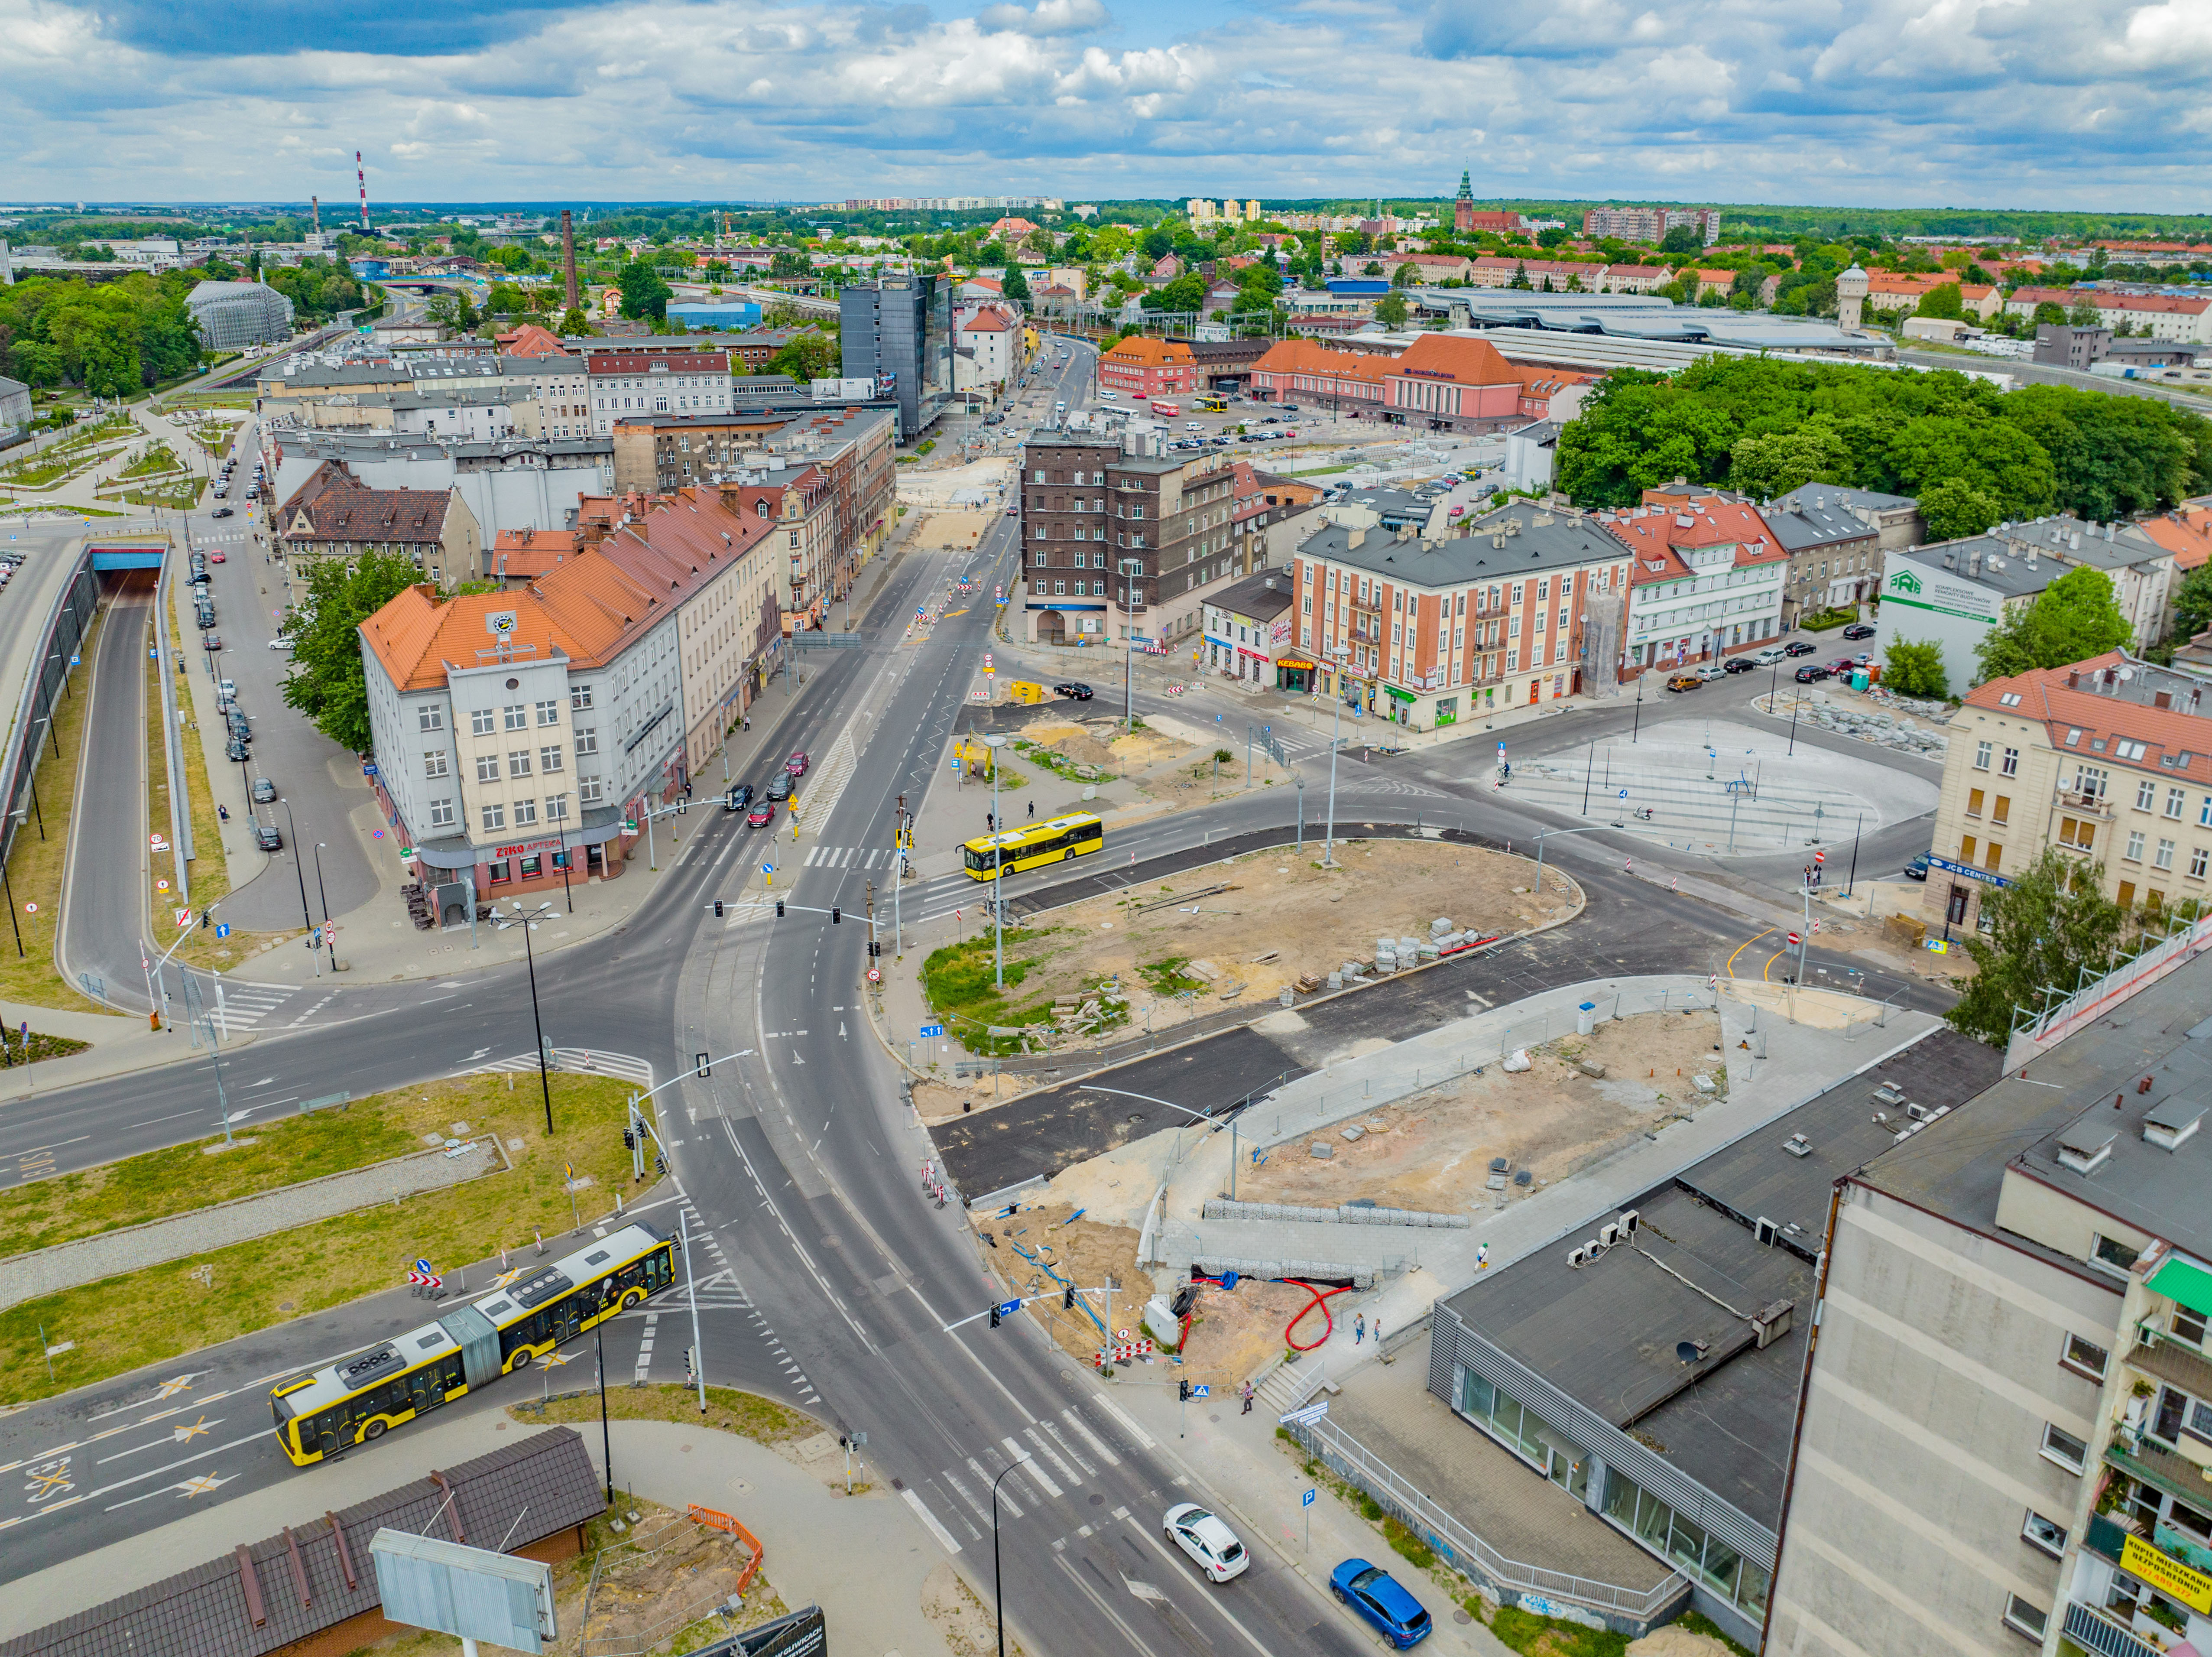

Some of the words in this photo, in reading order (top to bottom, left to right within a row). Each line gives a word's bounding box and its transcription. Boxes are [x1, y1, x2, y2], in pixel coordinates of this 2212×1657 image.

[1934, 589, 1959, 598] REMONTY
[1960, 594, 1991, 604] BUDYNKÓW
[1935, 584, 1974, 595] KOMPLEKSOWE
[1932, 606, 1990, 622] www.remonty.gliwice.pl
[1278, 660, 1306, 668] KEBAB
[526, 839, 561, 851] APTEKA
[1946, 864, 1962, 874] JCB
[1964, 869, 1997, 884] CENTER
[19, 1151, 57, 1179] BUS
[1306, 1491, 1313, 1504] P
[2133, 1552, 2200, 1594] BEZPOŚREDNIO
[2156, 1555, 2212, 1592] MIESZKANIE
[783, 1626, 822, 1656] GLIWICACH
